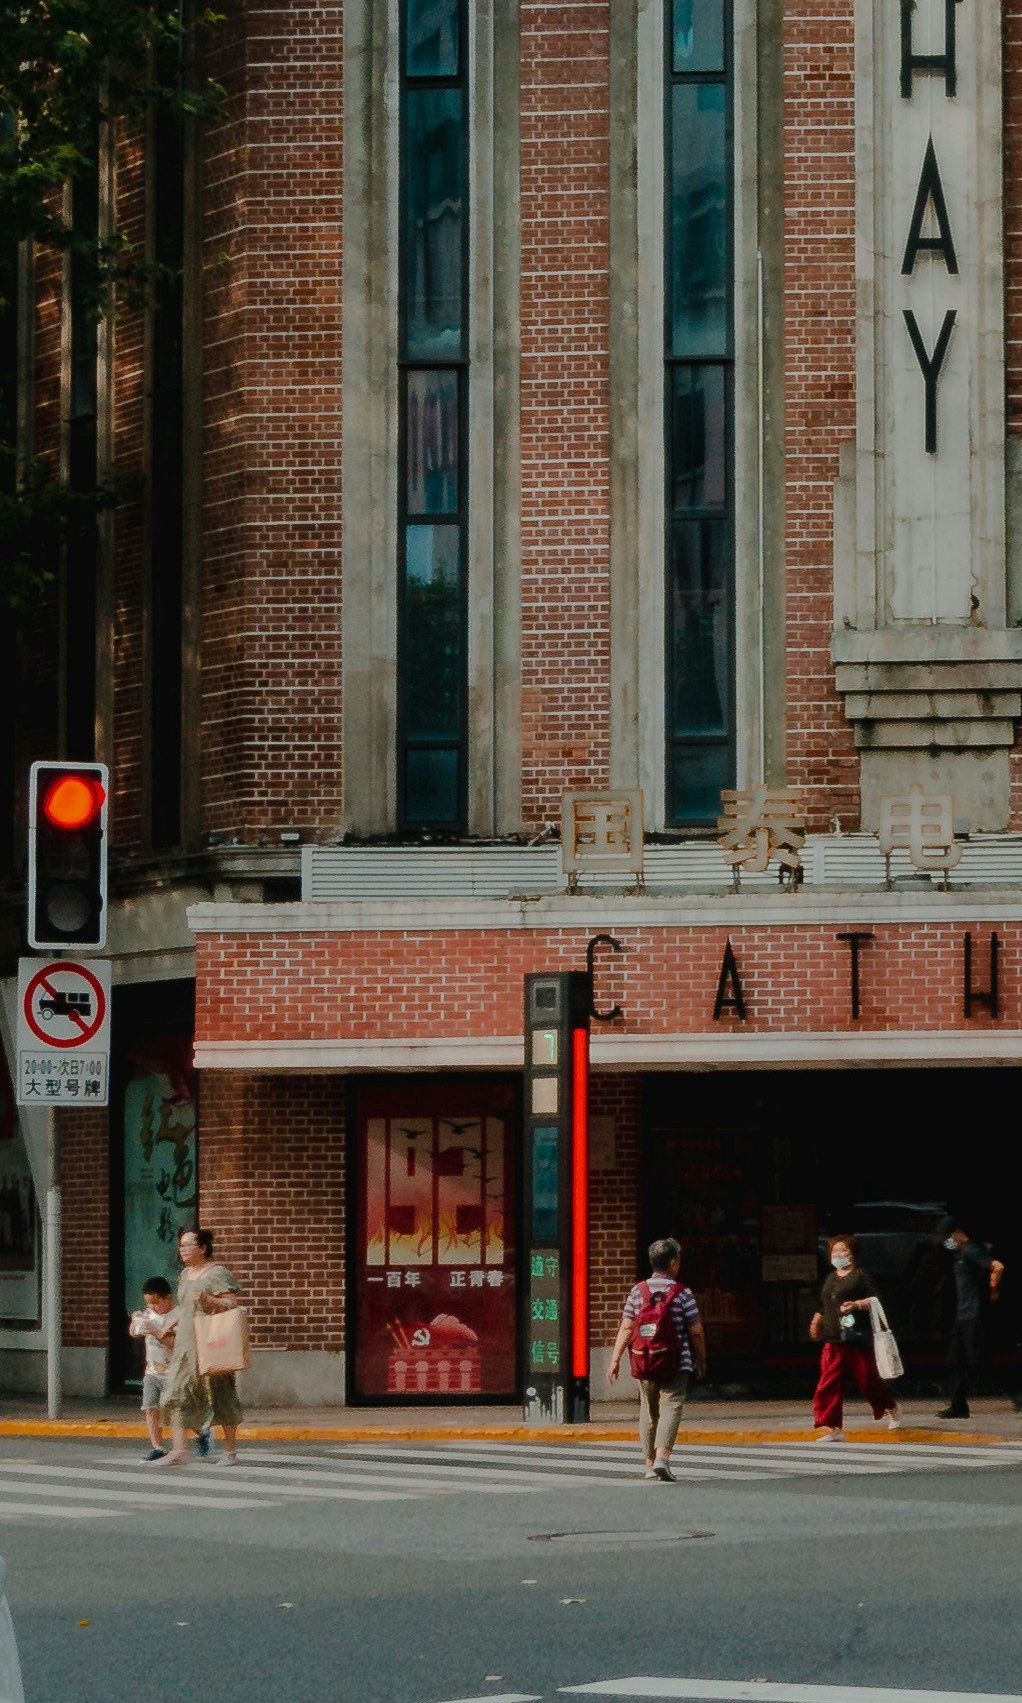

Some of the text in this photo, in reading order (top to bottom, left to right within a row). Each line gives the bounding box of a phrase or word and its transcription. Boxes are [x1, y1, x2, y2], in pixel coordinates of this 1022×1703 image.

[25, 1078, 101, 1097] 大型号牌
[531, 1256, 559, 1277] 遵守
[367, 1270, 504, 1288] 一百年 正青春
[531, 1299, 559, 1321] 交通
[531, 1341, 559, 1365] 信号
